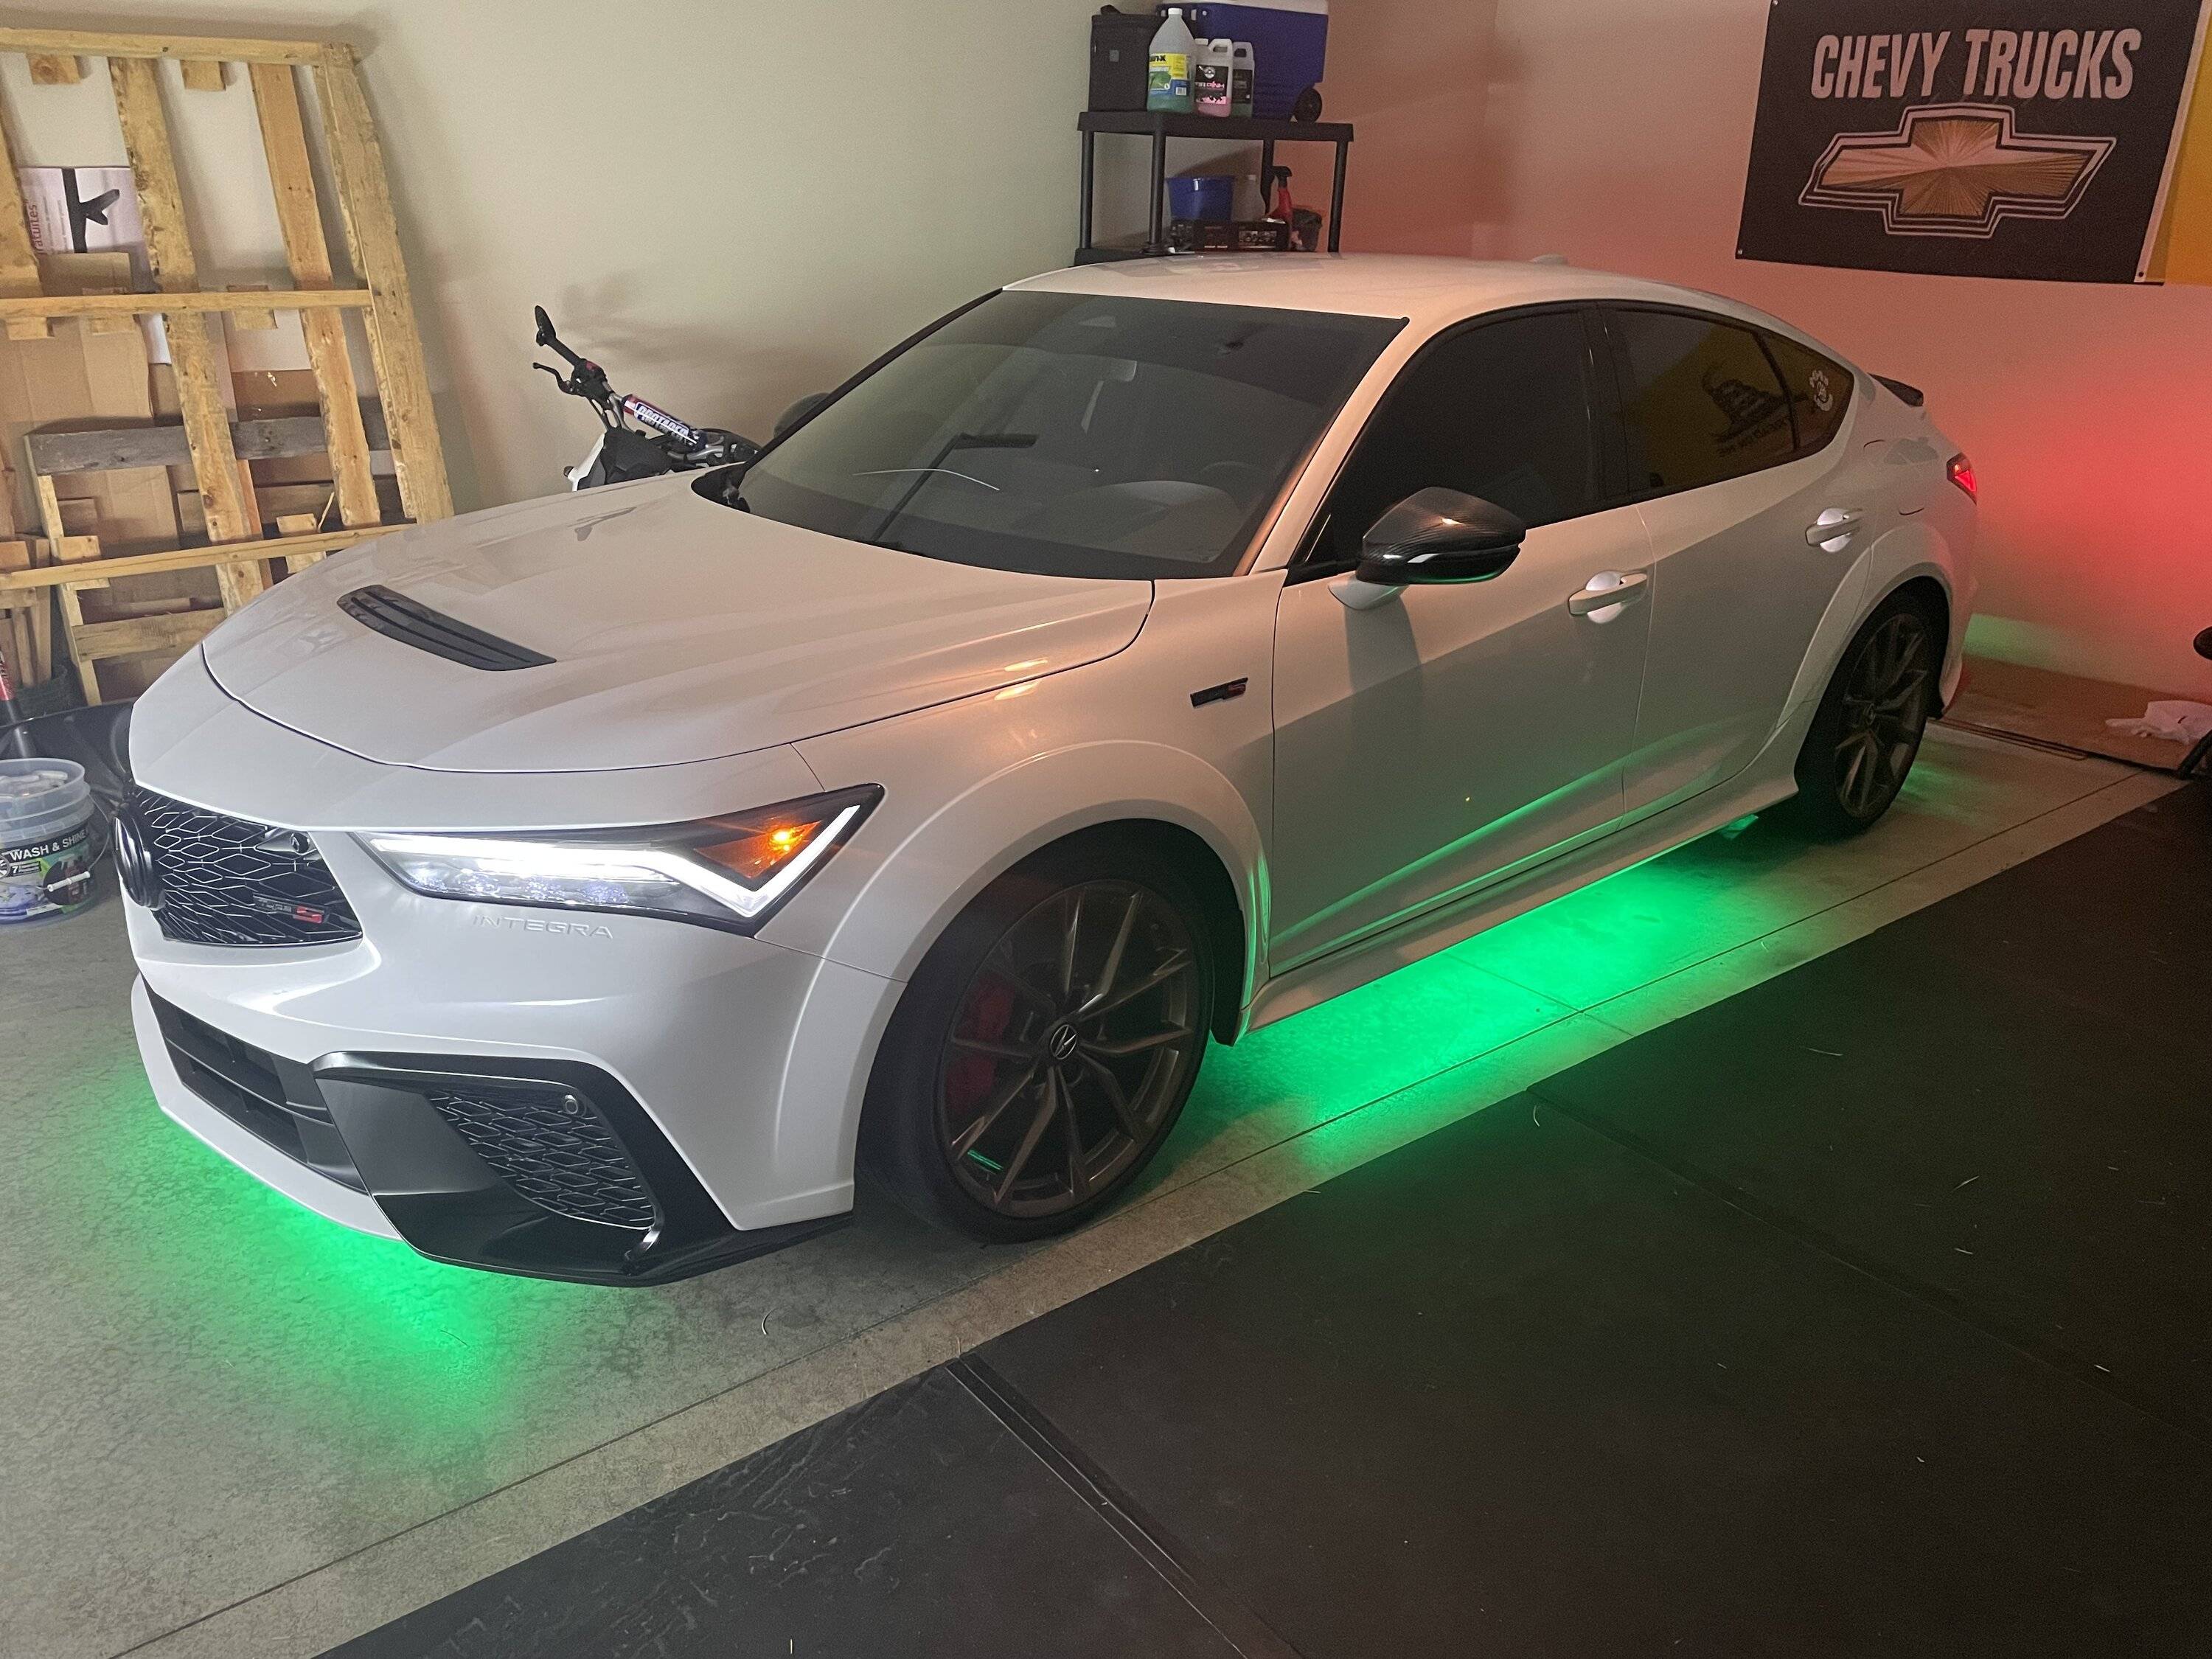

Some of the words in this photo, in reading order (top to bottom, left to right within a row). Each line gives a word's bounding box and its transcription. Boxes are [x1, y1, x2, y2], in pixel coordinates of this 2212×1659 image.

[1811, 31, 1950, 99] CHEVY
[1962, 29, 2141, 100] TRUCKS
[10, 844, 49, 861] WASH
[52, 842, 60, 852] &
[473, 915, 613, 939] INTEGRA
